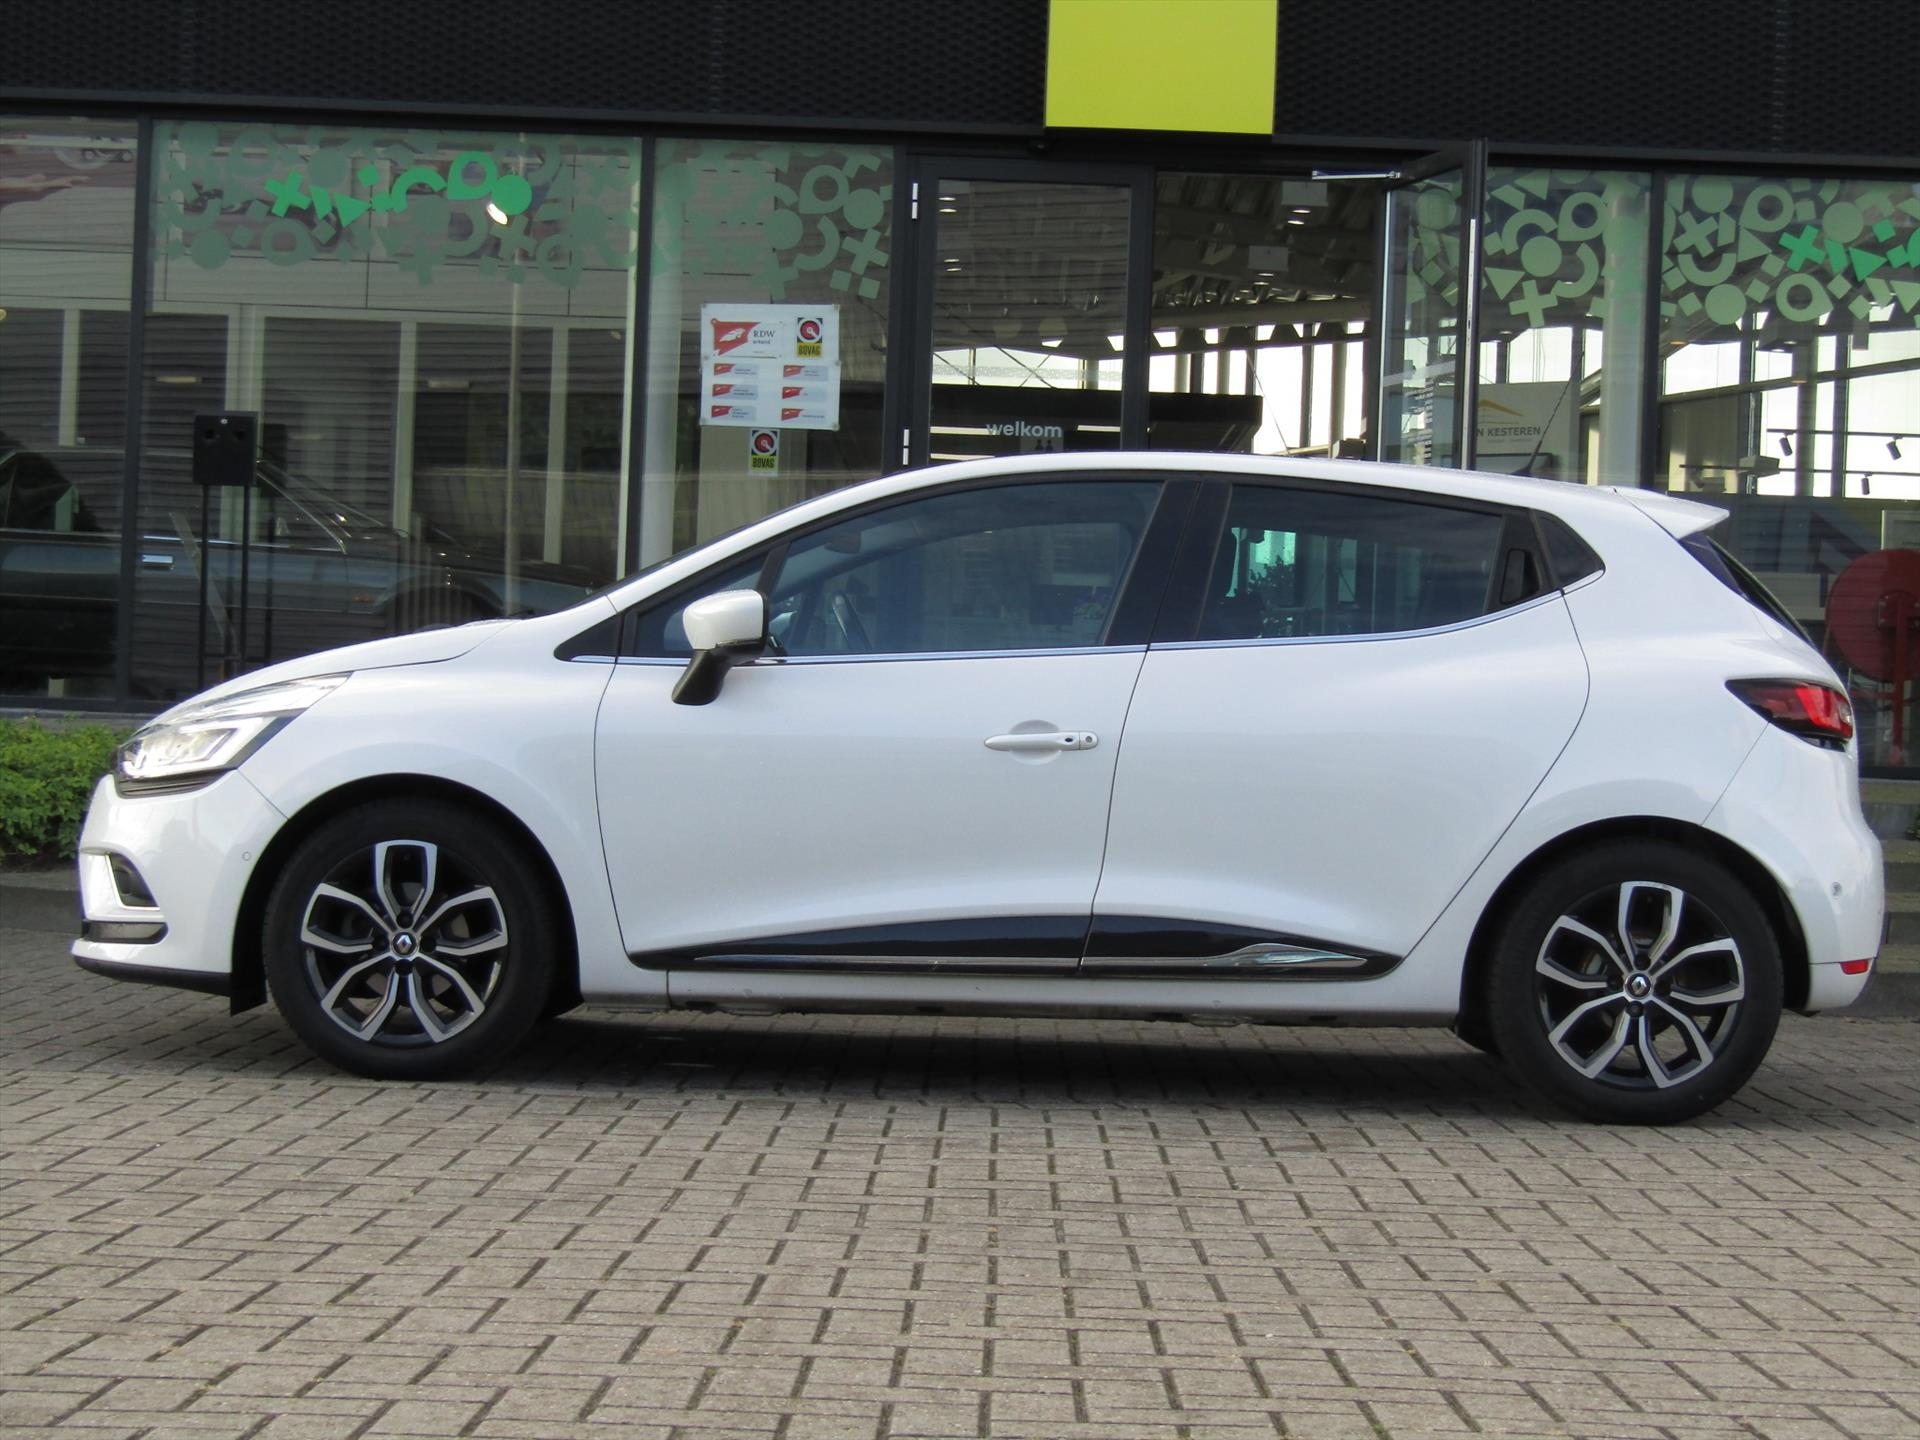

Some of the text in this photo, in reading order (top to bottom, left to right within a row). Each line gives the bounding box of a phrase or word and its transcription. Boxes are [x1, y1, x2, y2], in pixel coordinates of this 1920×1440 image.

[753, 329, 776, 338] RDW
[798, 344, 821, 356] BOVAG
[986, 421, 1063, 437] welkom
[1487, 426, 1541, 437] KESTEREN
[752, 457, 775, 469] BOVAG
